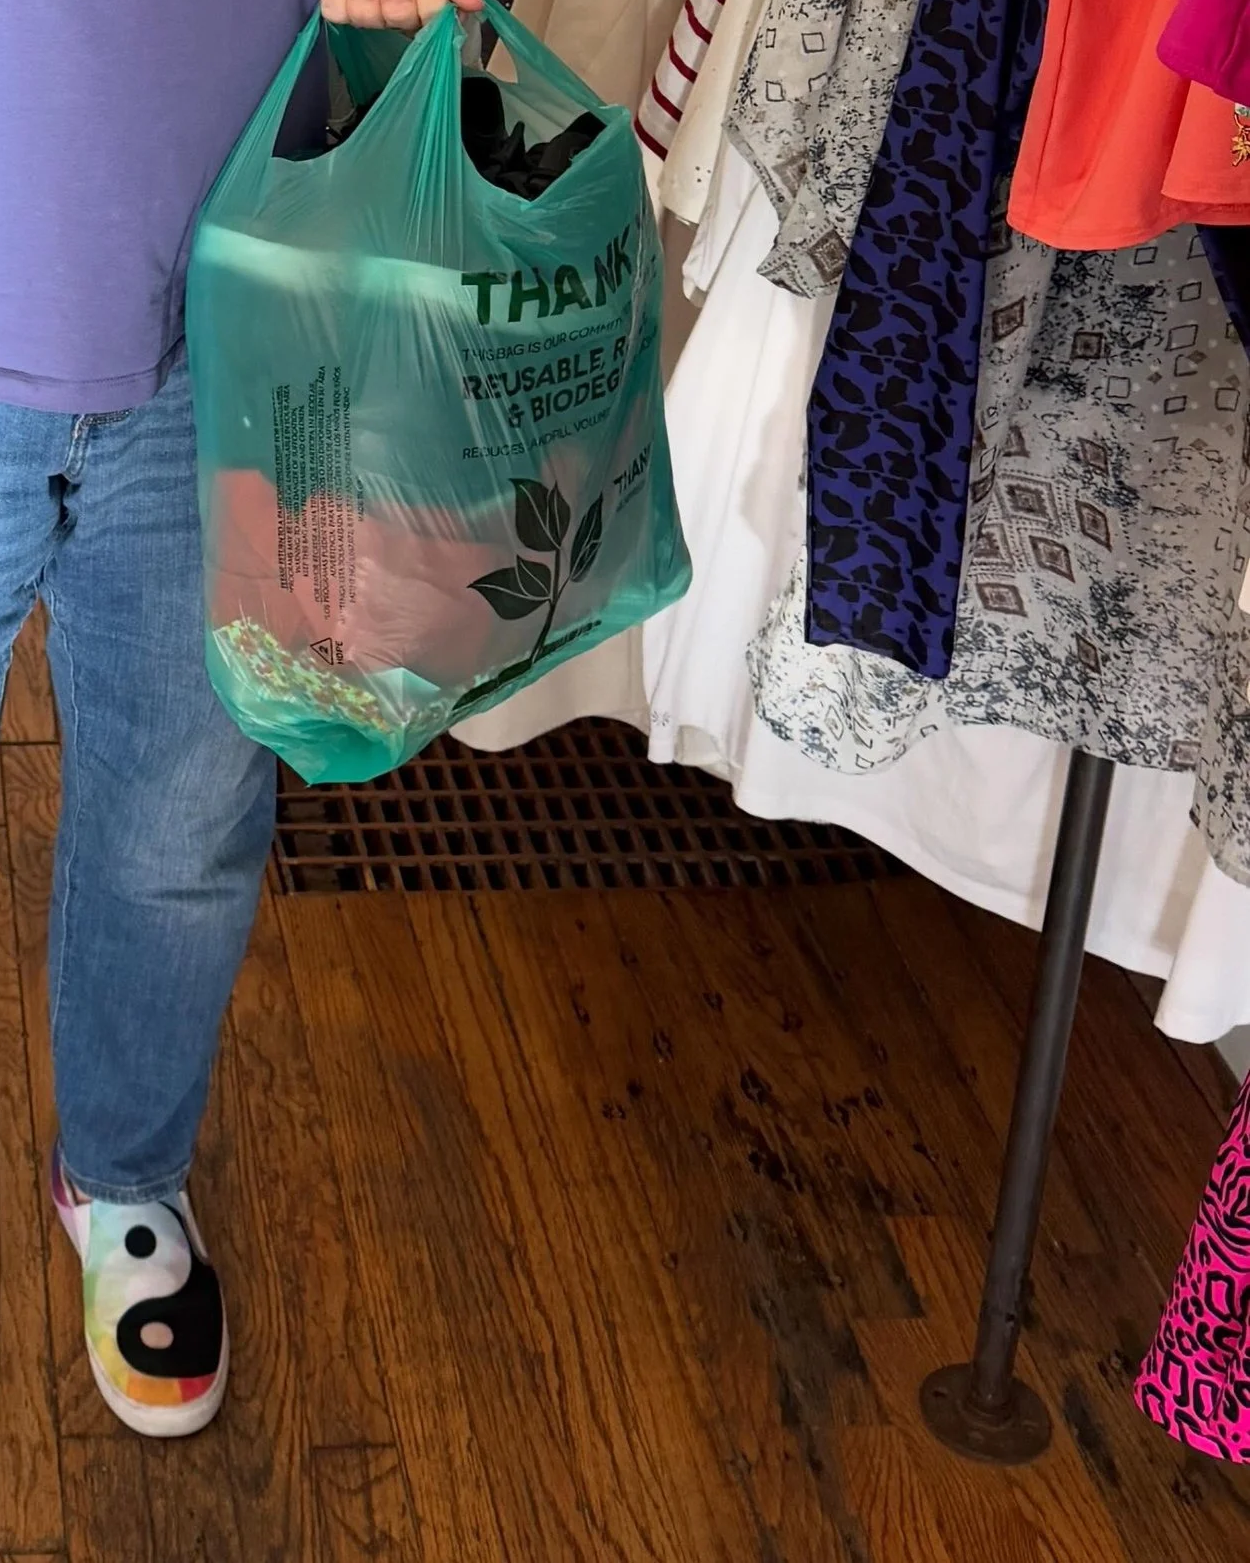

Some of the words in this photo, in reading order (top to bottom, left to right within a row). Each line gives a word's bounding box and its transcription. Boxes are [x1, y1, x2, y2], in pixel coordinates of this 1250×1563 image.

[461, 223, 632, 326] THANK
[497, 343, 525, 360] BAG
[527, 341, 541, 353] IS
[543, 331, 567, 351] OUR
[530, 362, 626, 423] BIODEG
[318, 645, 329, 655] 2
